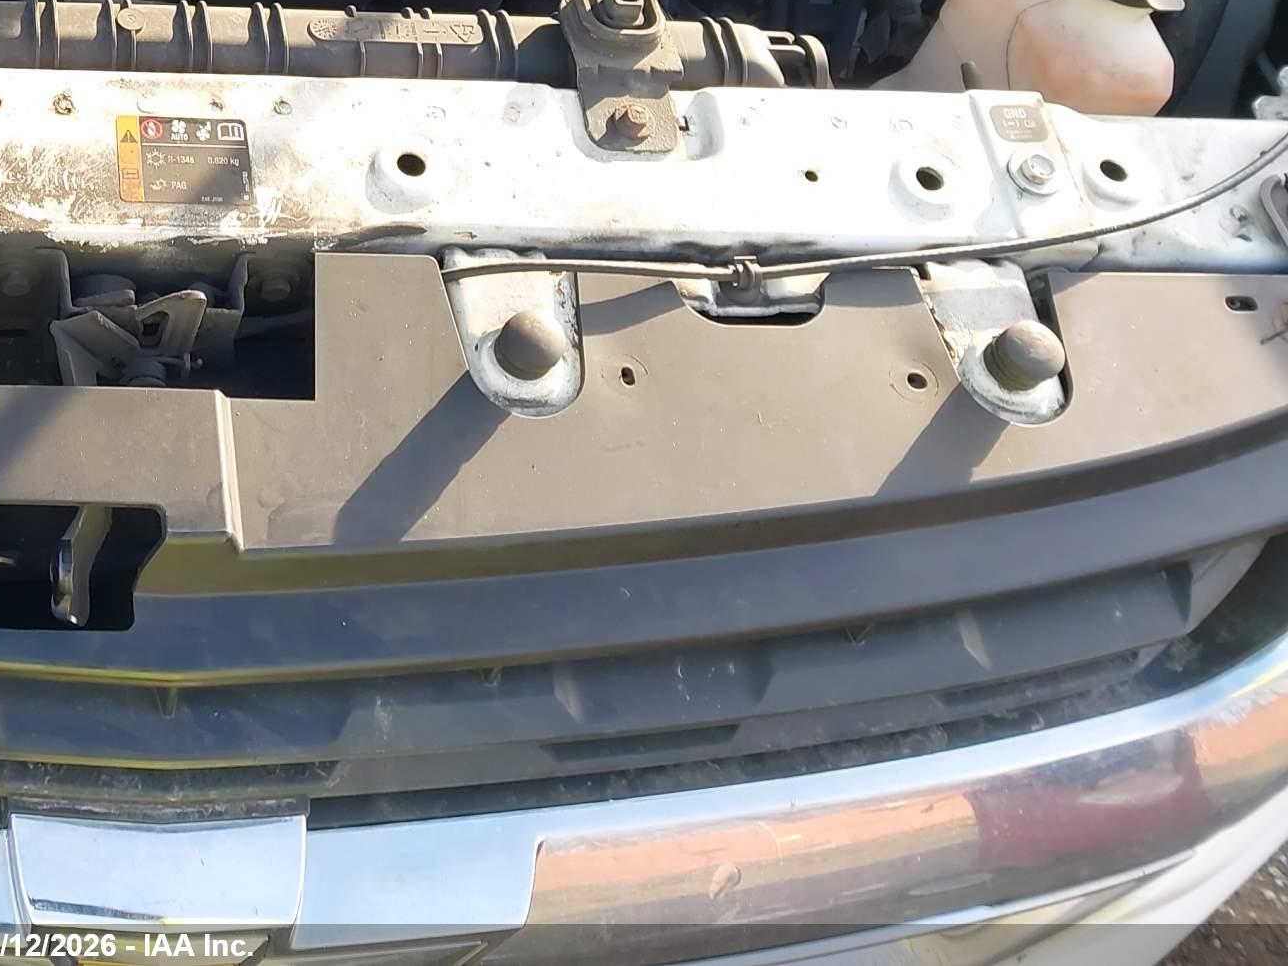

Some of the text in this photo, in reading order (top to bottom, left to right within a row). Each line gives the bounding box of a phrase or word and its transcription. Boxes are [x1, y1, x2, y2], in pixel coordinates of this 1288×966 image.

[170, 132, 189, 141] AUTO
[229, 157, 240, 166] kg
[171, 180, 187, 189] PAG
